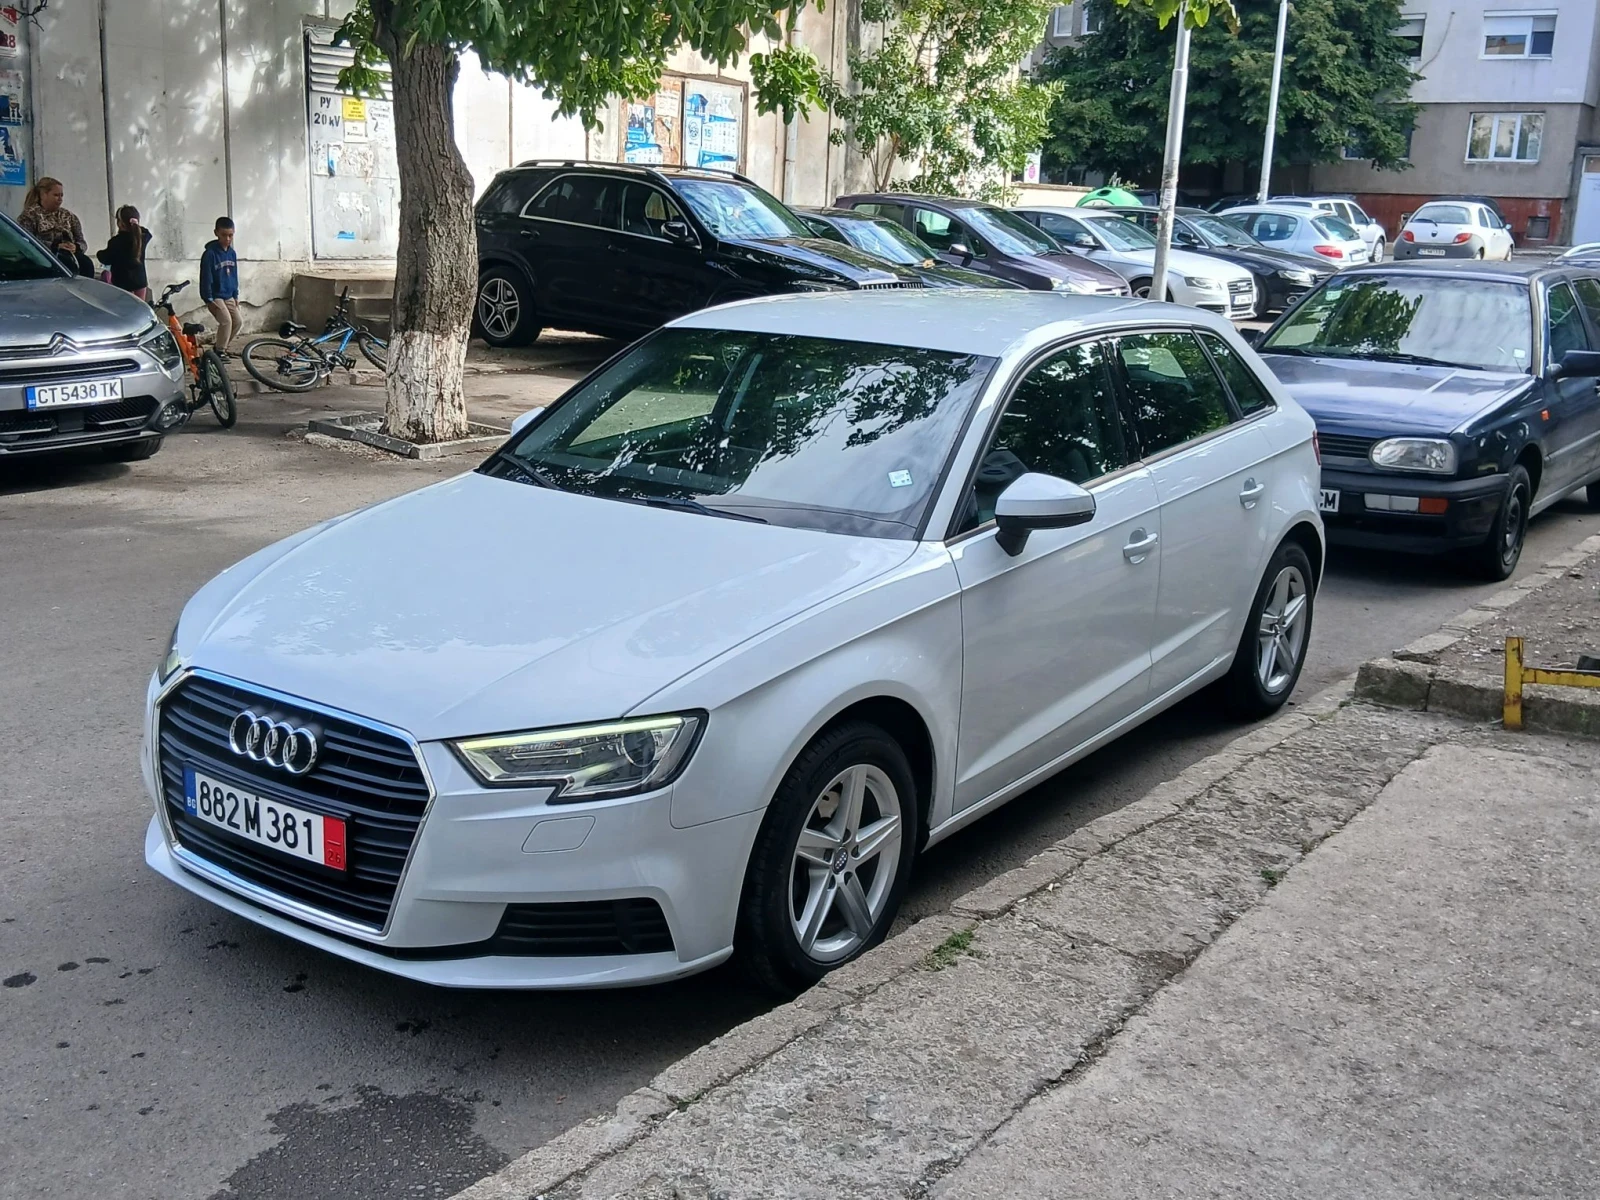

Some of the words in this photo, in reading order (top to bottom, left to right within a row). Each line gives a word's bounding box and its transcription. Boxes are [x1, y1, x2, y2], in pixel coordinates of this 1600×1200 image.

[314, 112, 327, 125] 20
[61, 384, 97, 401] 5438
[187, 796, 196, 809] BG
